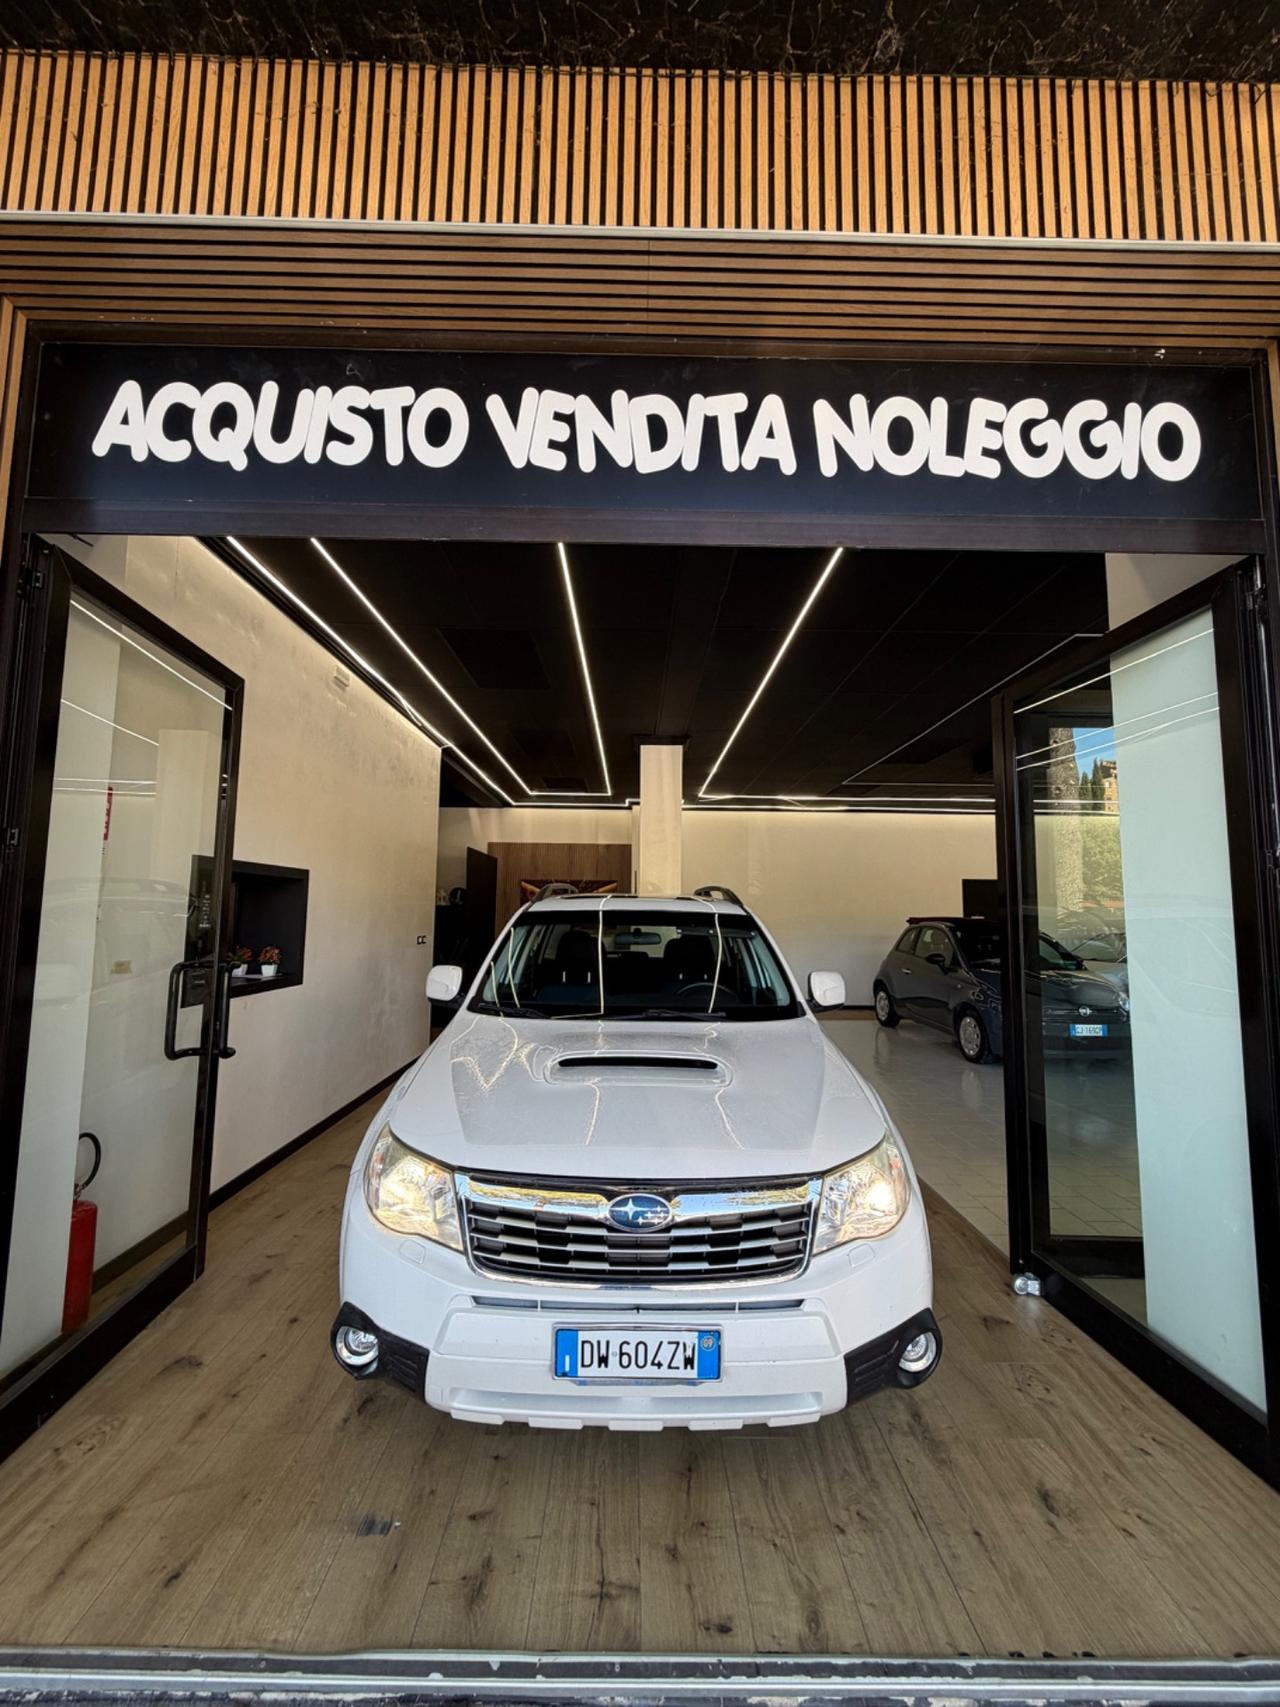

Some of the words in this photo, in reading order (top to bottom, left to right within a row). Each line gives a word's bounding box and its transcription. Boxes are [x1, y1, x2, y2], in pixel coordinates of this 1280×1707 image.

[91, 379, 470, 472] ACQUISTO
[485, 386, 798, 476] VENDITA
[812, 393, 1202, 482] NOLEGGIO
[580, 1339, 610, 1369] DW
[618, 1340, 696, 1371] 604ZW
